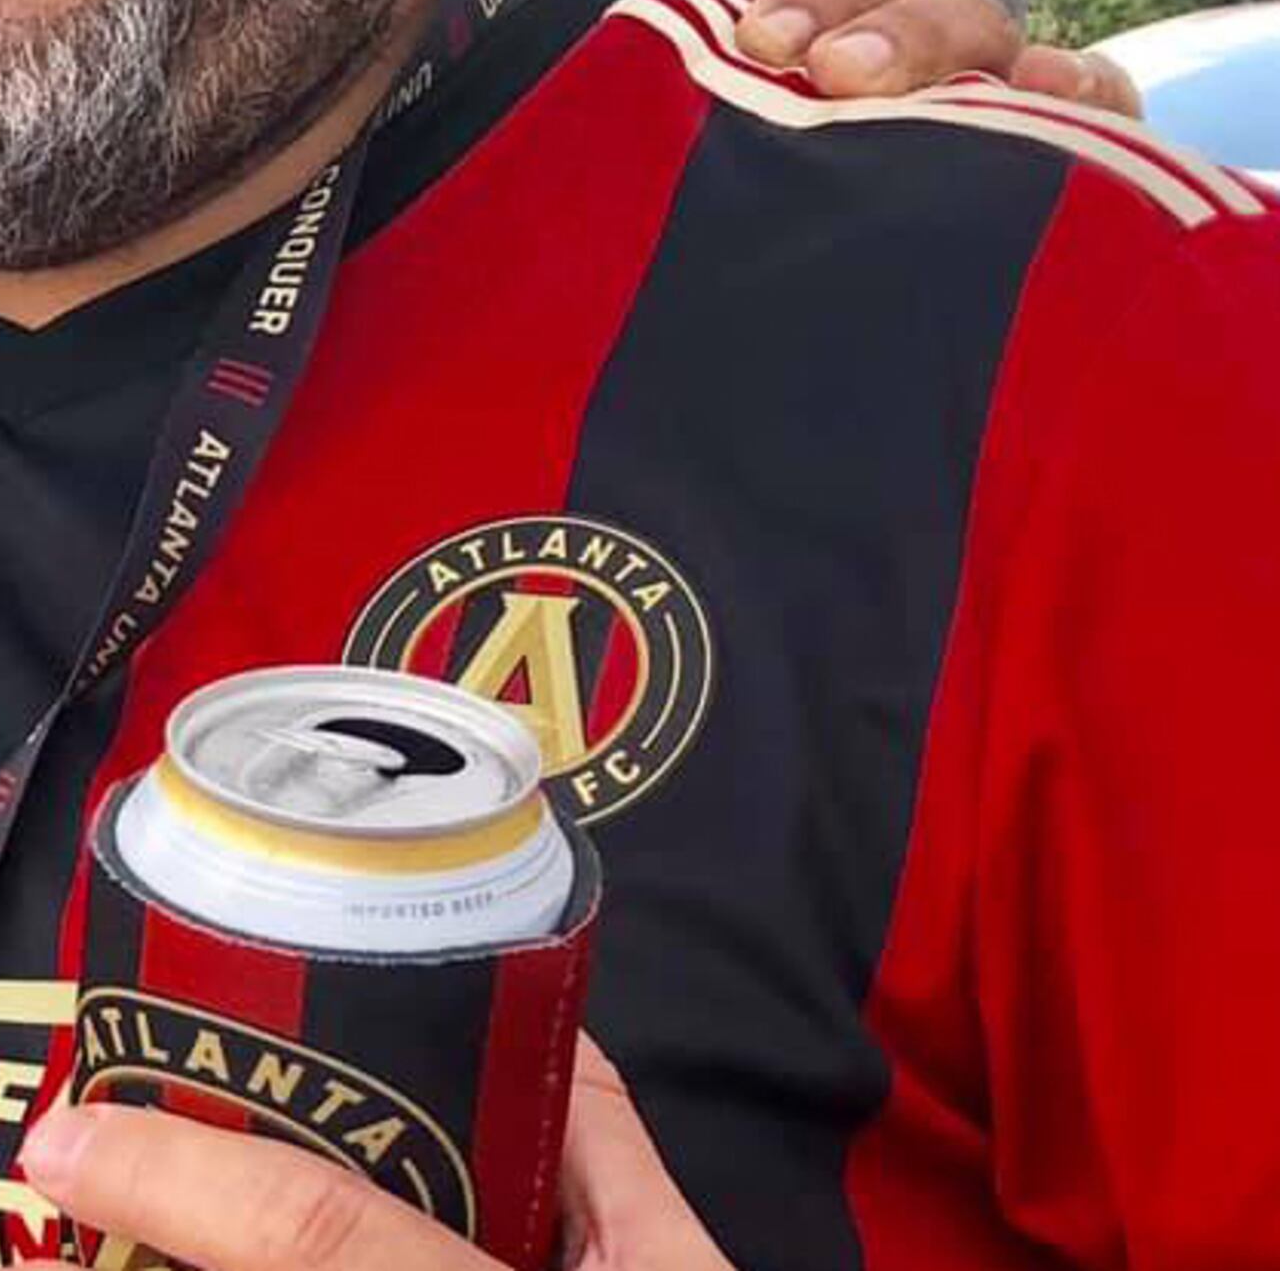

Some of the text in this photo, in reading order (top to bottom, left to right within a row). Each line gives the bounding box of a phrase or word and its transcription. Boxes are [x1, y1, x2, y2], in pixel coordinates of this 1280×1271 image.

[89, 430, 231, 679] ATLANTA UNI
[426, 528, 674, 613] ATLANTA
[571, 750, 642, 806] FC
[83, 1006, 408, 1162] ATLANTA
